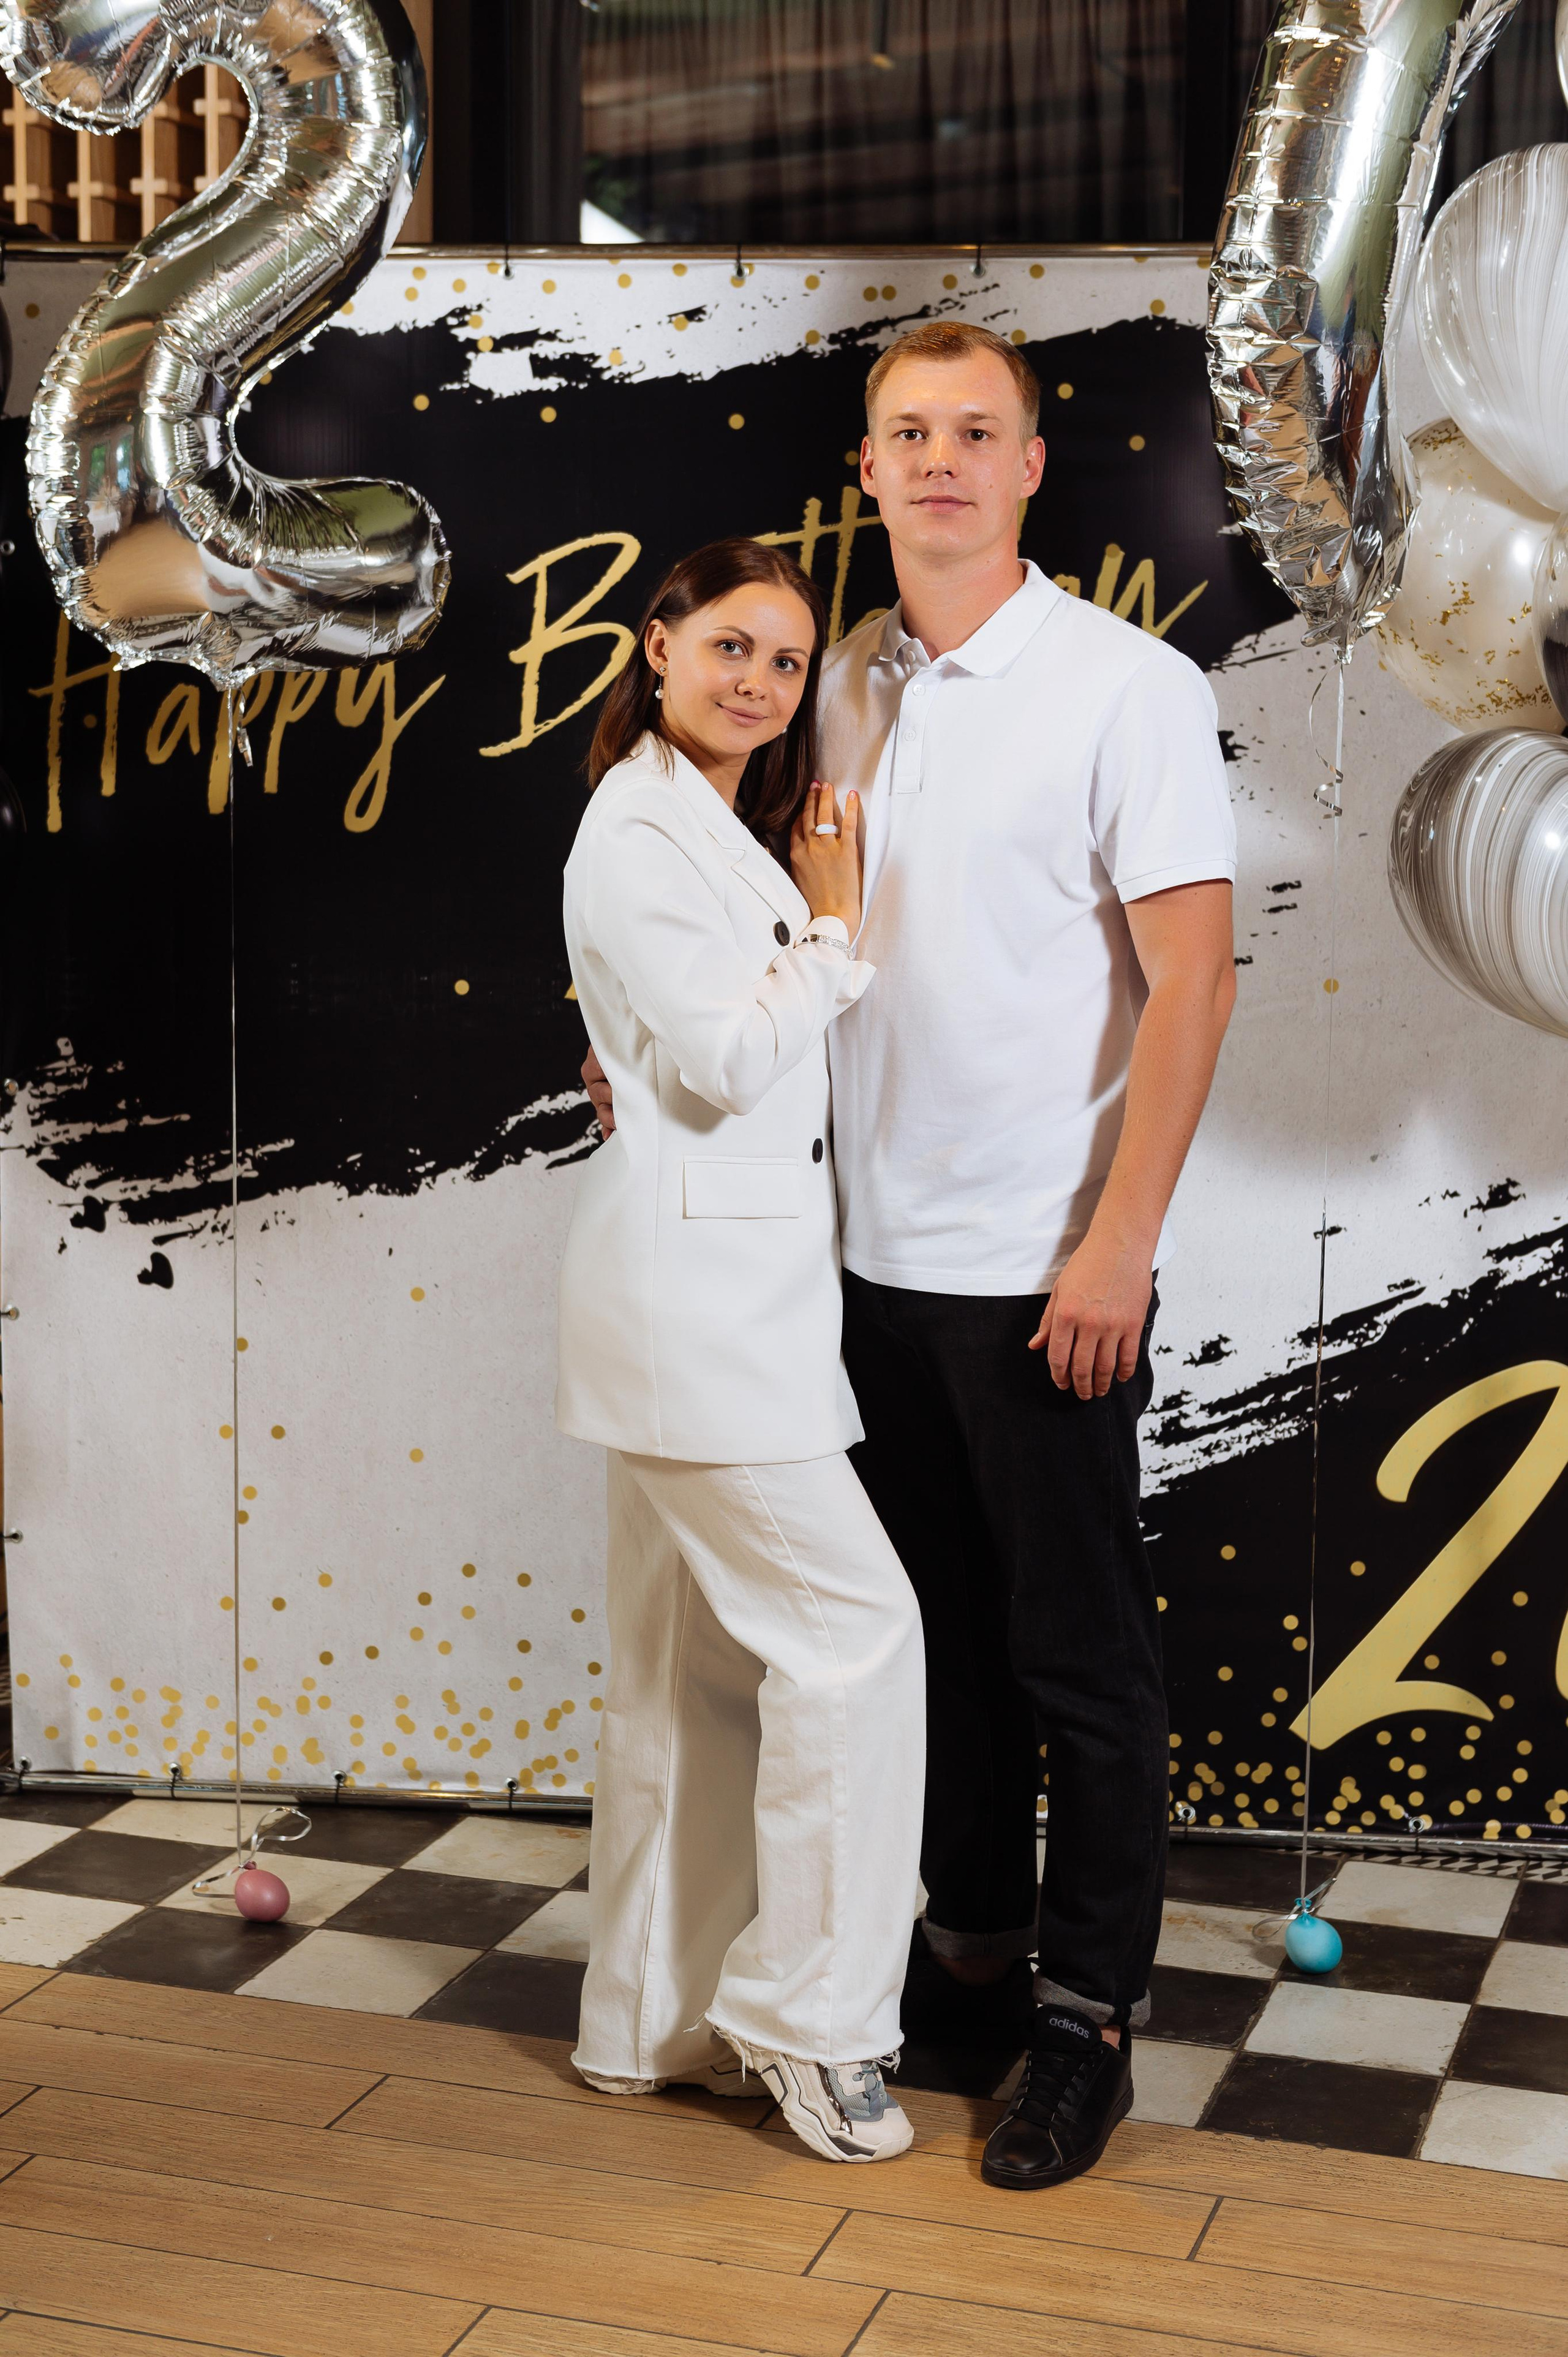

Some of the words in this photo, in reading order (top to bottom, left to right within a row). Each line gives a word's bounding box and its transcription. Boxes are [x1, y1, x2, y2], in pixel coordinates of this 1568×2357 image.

[28, 613, 446, 833] Happy
[1289, 1360, 1568, 1751] 2
[1049, 2018, 1090, 2038] adidas
